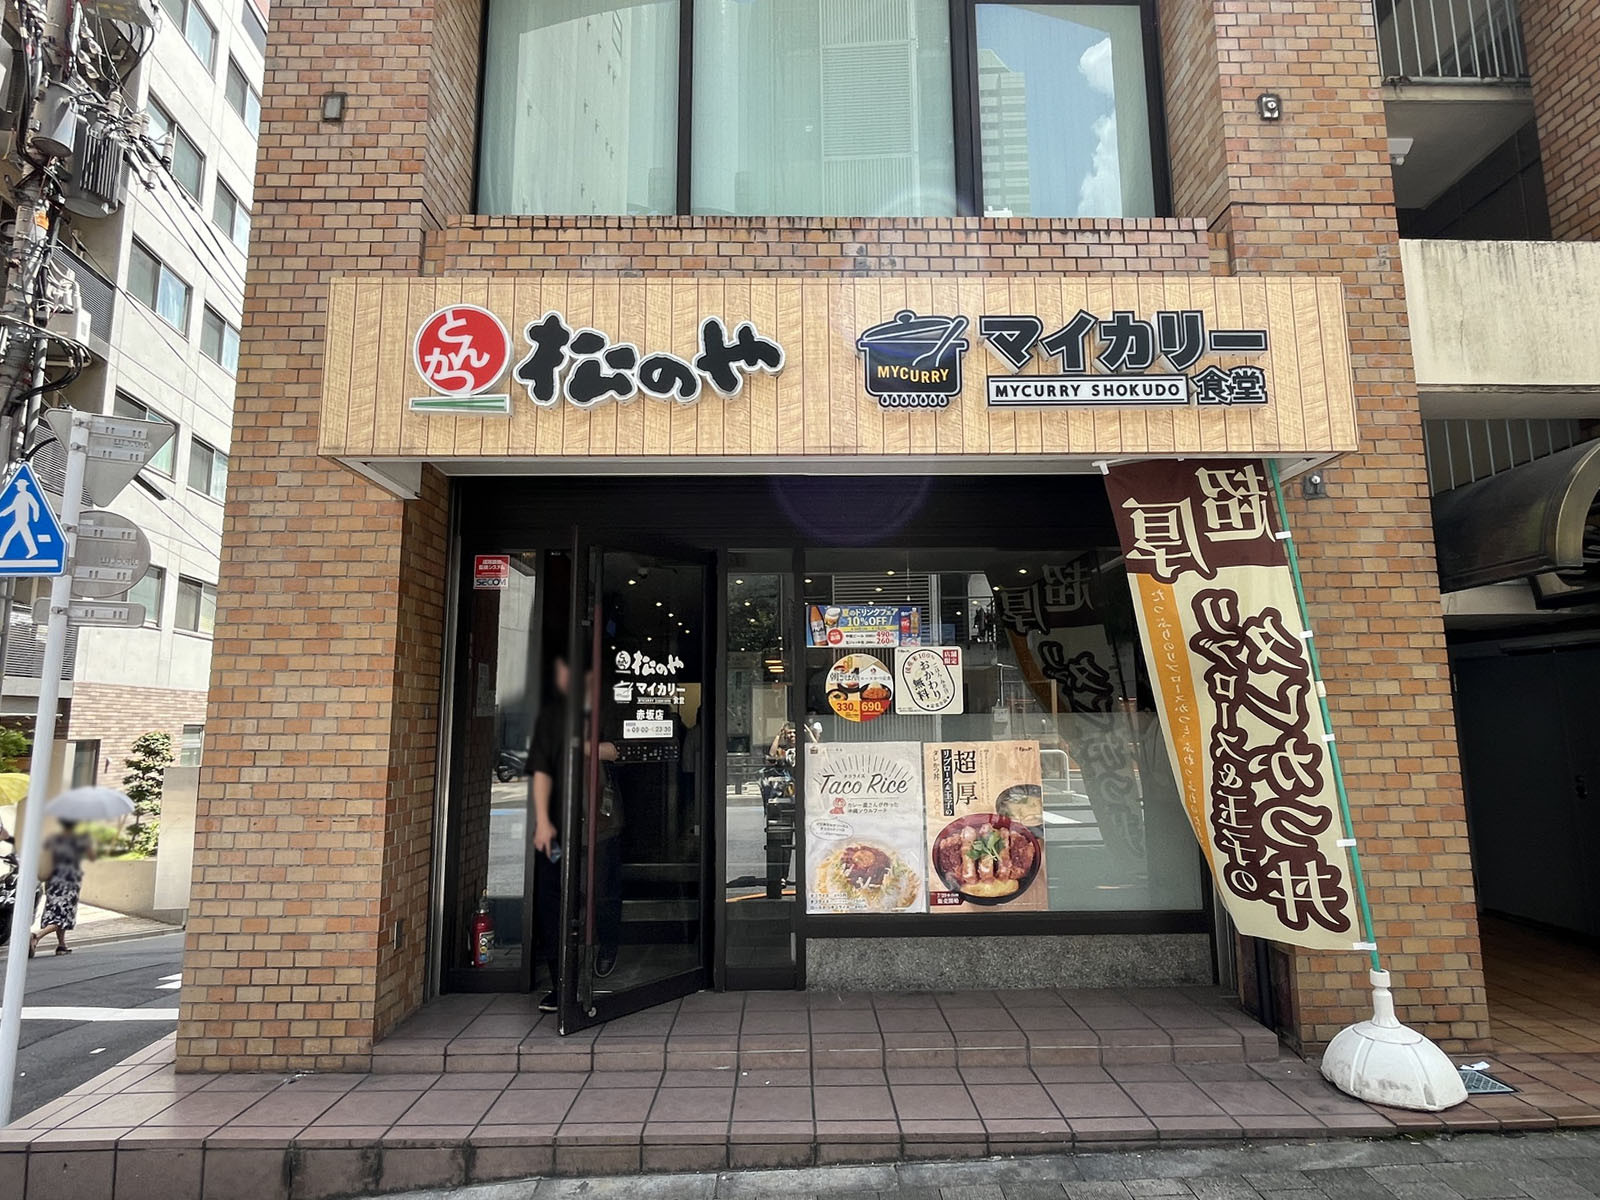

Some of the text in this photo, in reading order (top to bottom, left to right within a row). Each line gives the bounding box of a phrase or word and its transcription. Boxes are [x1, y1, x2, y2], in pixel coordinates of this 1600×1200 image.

[424, 308, 491, 394] とんかつ
[979, 310, 1268, 374] マイカリー
[515, 312, 785, 408] 松のや
[877, 365, 949, 385] MYCURRY
[1193, 366, 1268, 404] 食堂
[995, 383, 1180, 398] MYCURRY SHOKUDO
[476, 578, 507, 586] SECOM
[847, 616, 888, 627] 10%OFF
[632, 650, 684, 676] 松のや
[636, 682, 685, 696] マイカリー
[912, 678, 930, 702] 無料
[919, 660, 942, 700] おかわり
[636, 709, 664, 721] 赤坂店
[820, 773, 908, 795] Taco Rice
[953, 750, 978, 806] 超厚
